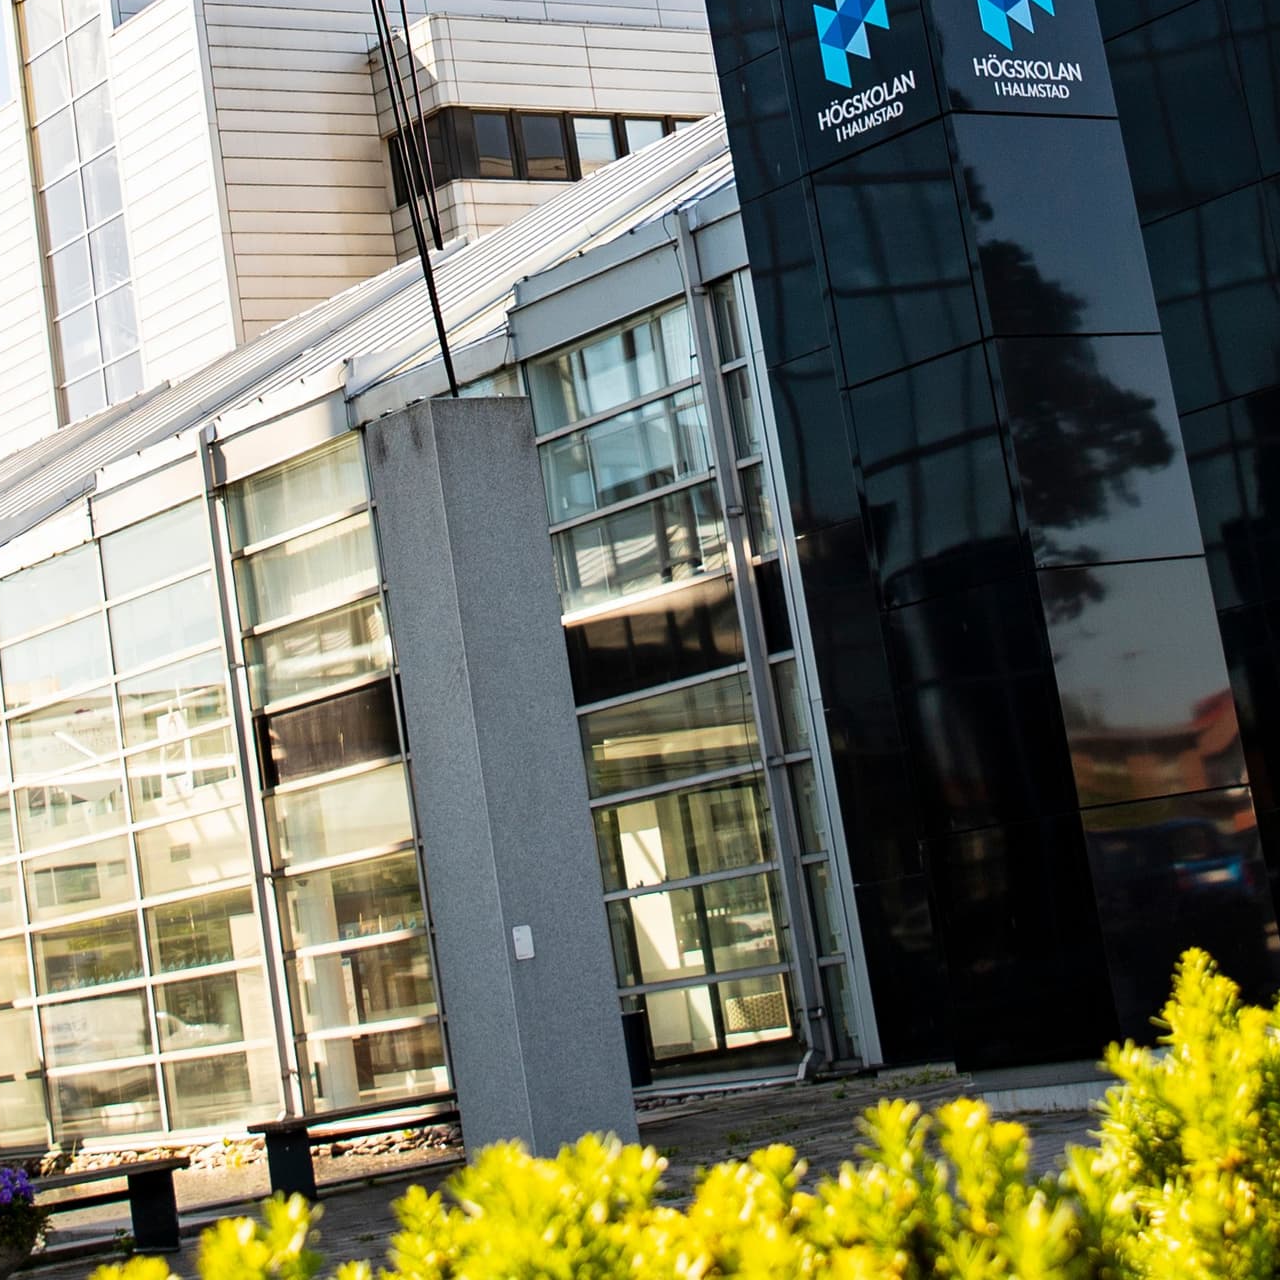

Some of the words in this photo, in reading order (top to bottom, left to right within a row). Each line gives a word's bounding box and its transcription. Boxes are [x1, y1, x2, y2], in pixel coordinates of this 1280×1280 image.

[972, 53, 1083, 82] HÖGSKOLAN
[817, 70, 916, 131] HÖGSKOLAN
[994, 81, 1000, 96] I
[1001, 81, 1070, 99] HALMSTAD
[836, 128, 841, 142] I
[842, 101, 904, 140] HALMSTAD
